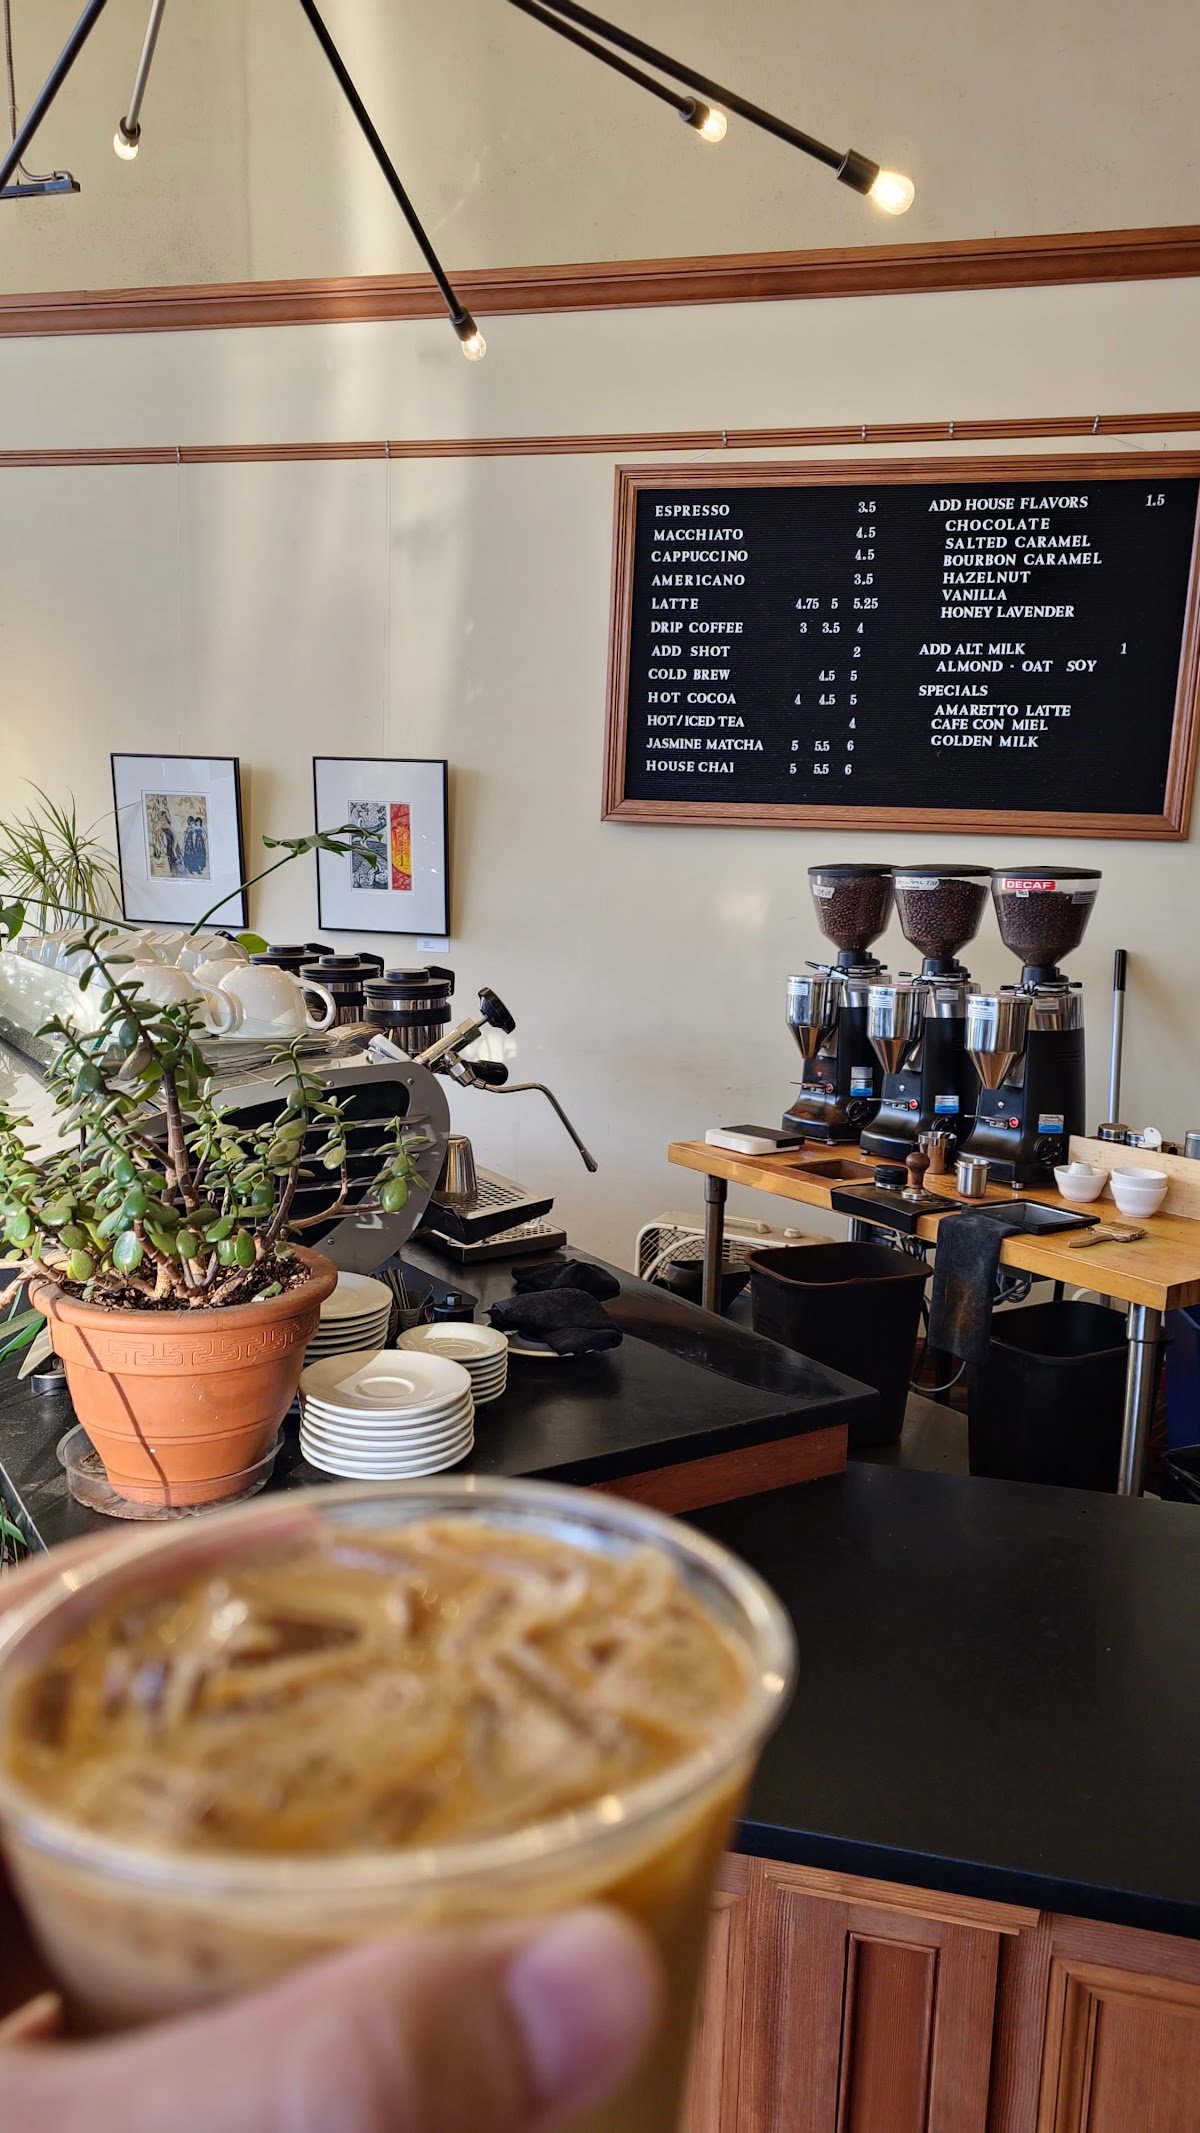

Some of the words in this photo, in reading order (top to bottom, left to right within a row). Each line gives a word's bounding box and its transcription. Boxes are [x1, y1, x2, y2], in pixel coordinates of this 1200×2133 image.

[655, 504, 730, 517] ESPRESSO
[857, 500, 877, 514] 3.5
[928, 498, 962, 512] ADD
[964, 497, 1016, 511] HOUSE
[1019, 495, 1089, 510] FLAVORS
[1145, 493, 1165, 507] 1.5
[945, 517, 1051, 532] CHOCOLATE
[653, 528, 744, 542] MACCHIATO
[855, 526, 876, 539] 4.5
[945, 536, 1008, 550] SALTED
[1014, 534, 1091, 549] CARAMEL
[650, 549, 749, 563] CAPPUCCINO
[854, 548, 875, 561] 4.5
[943, 553, 1017, 567] BOURBON
[1023, 552, 1103, 566] CARAMEL
[651, 573, 746, 587] AMERICANO
[853, 572, 874, 586] 3.5
[942, 570, 1032, 585] HAZELNUT
[941, 588, 1008, 602] VANILLA
[651, 597, 699, 610] LATTE
[795, 597, 820, 610] 4.75
[830, 597, 839, 610] 5
[852, 597, 879, 610] 5.25
[940, 605, 994, 619] HONEY
[996, 605, 1075, 618] LAVENDER
[650, 620, 684, 634] DRIP
[688, 621, 744, 634] COFFEE
[799, 621, 808, 634] 3
[821, 621, 841, 634] 3.5
[856, 622, 864, 634] 4
[651, 644, 682, 657] ADD
[689, 645, 731, 658] SHOT
[852, 646, 861, 658] 2
[918, 643, 952, 656] ADD
[987, 642, 1026, 655] MILK
[1120, 642, 1127, 655] 1
[935, 659, 1004, 673] ALMOND
[1021, 660, 1054, 673] OAT
[1065, 659, 1098, 673] SOY
[647, 668, 688, 681] COLD
[692, 668, 731, 681] BREW
[818, 669, 836, 682] 4.5
[849, 669, 858, 682] 5
[918, 684, 989, 697] SPECIALS
[647, 691, 682, 704] HOT
[686, 692, 737, 705] COCOA
[794, 693, 802, 706] 4
[818, 693, 836, 706] 4.5
[849, 693, 858, 706] 5
[934, 703, 1019, 717] AMARETTO
[1025, 704, 1072, 717] LATTE
[647, 714, 716, 727] HOT/ICED
[717, 715, 745, 728] TEA
[848, 717, 856, 729] 4
[930, 718, 969, 731] CAFE
[972, 718, 1005, 731] CON
[1011, 718, 1049, 731] MIEL
[646, 737, 702, 750] JASMINE
[705, 738, 764, 751] MATCHA
[790, 739, 799, 752] 5
[846, 739, 855, 752] 6
[930, 734, 993, 747] GOLDEN
[998, 735, 1039, 748] MILK
[645, 759, 696, 773] HOUSE
[697, 761, 735, 773] CHAI
[789, 762, 797, 775] 5
[844, 763, 853, 776] 6
[1006, 880, 1052, 889] DECAF
